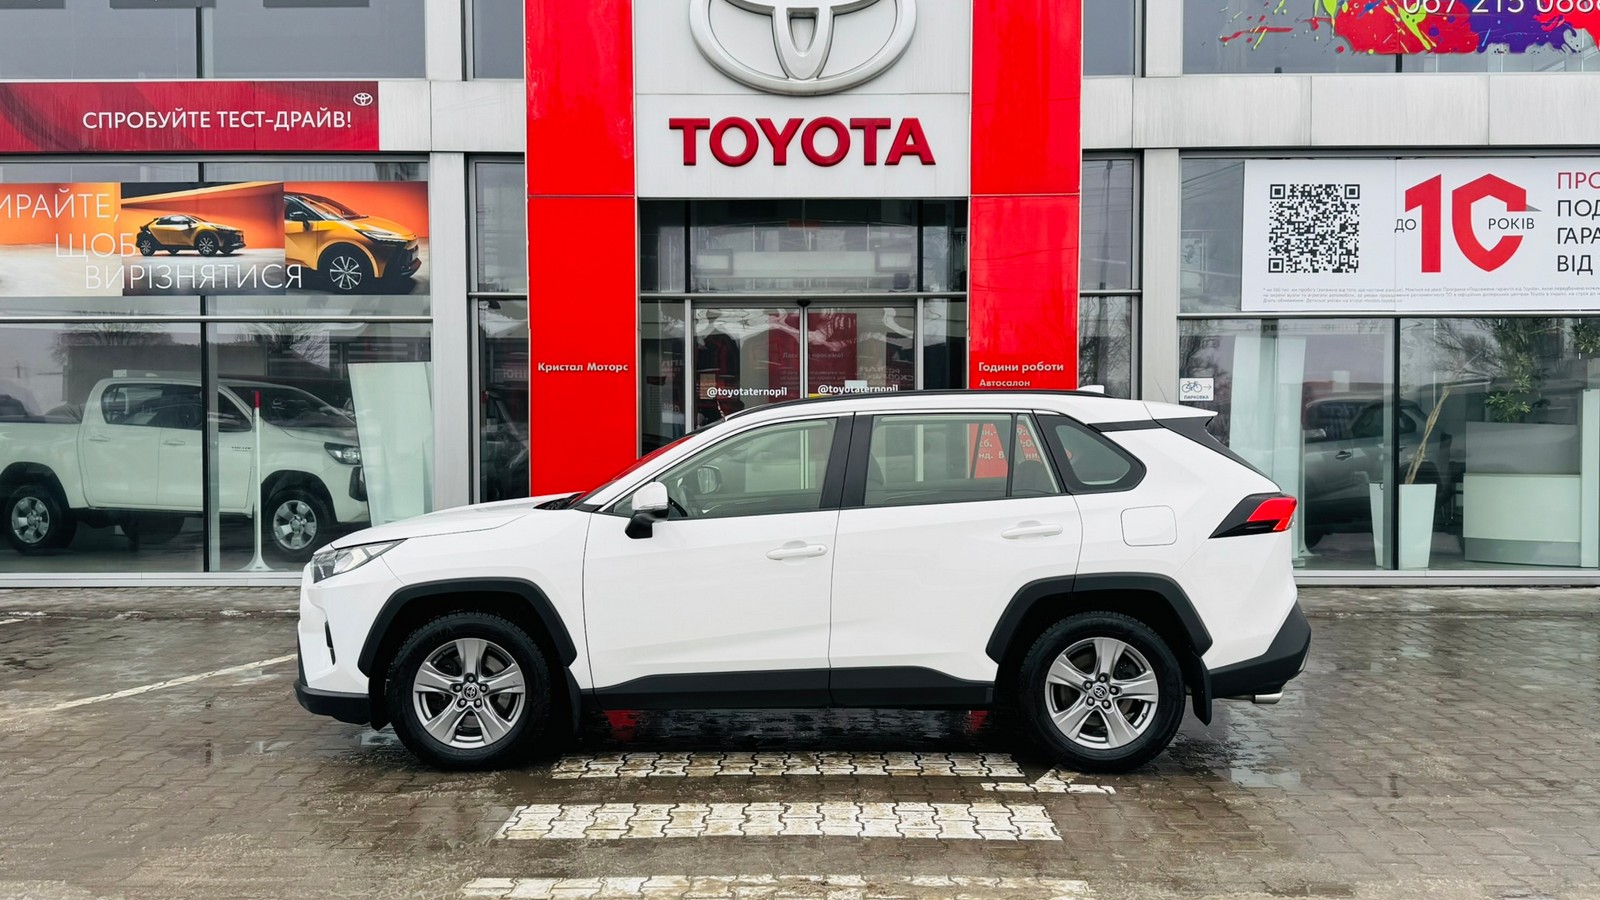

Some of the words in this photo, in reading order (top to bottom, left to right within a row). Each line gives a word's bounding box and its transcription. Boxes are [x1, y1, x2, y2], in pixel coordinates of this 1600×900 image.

[83, 107, 211, 129] СПРОБУЙТЕ
[216, 106, 352, 131] ТЕСТ-ДРАЙВ!
[668, 116, 937, 167] TOYOTA
[1395, 218, 1417, 233] ДО
[1488, 217, 1535, 230] РОКІВ
[55, 233, 137, 261] ЩОБ
[1557, 254, 1593, 276] ВІД
[85, 263, 303, 290] ВИРІЗНЯТИСЯ
[537, 362, 583, 374] Кристал
[587, 362, 629, 374] Моторс
[978, 361, 1019, 373] Години
[1022, 361, 1064, 374] роботи
[818, 384, 899, 396] @toyotaternopil
[979, 378, 1031, 387] Автосалон
[706, 386, 788, 399] @toyotaternopil
